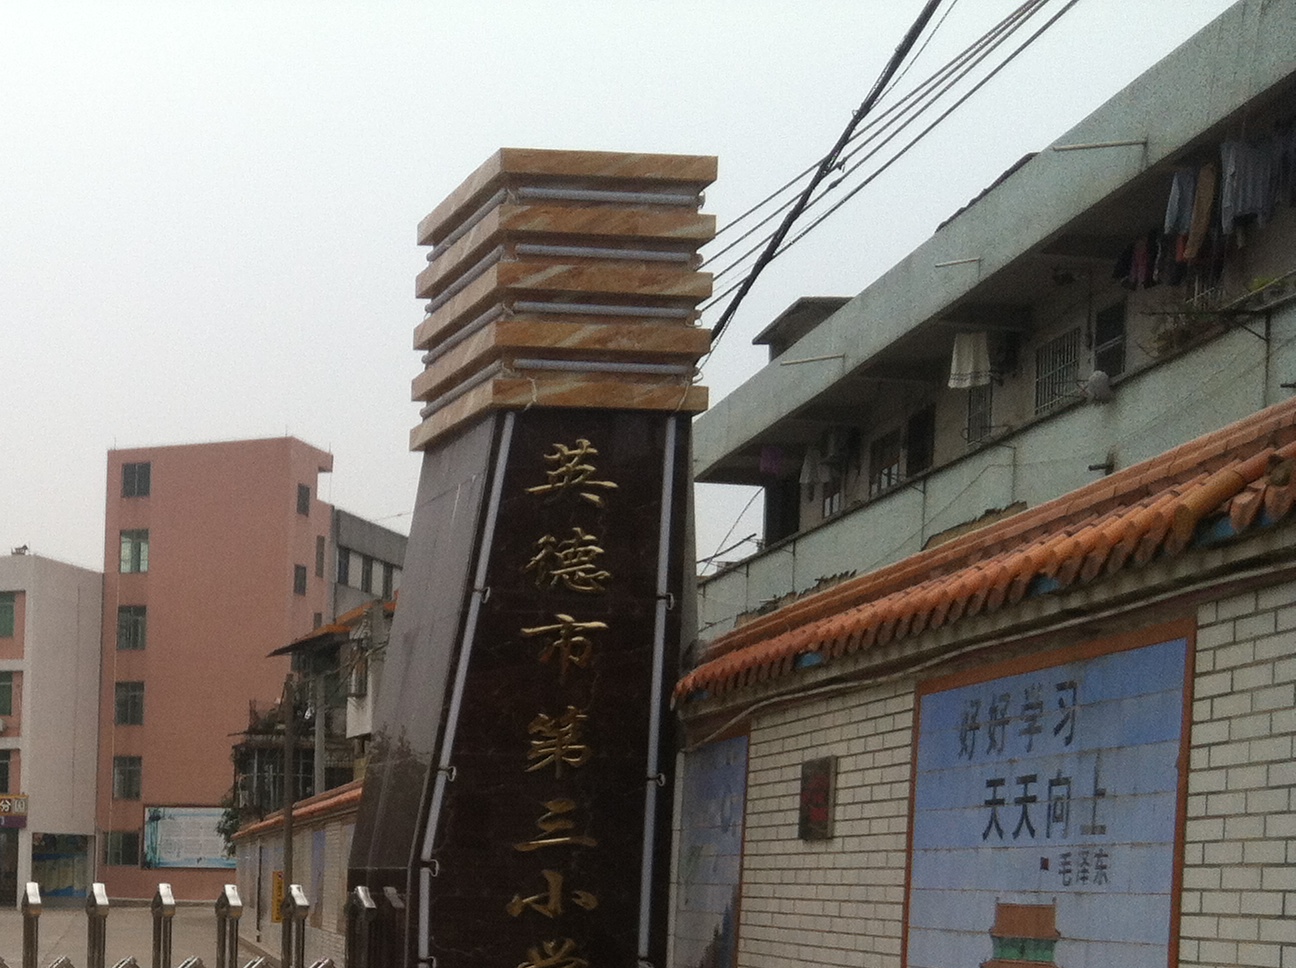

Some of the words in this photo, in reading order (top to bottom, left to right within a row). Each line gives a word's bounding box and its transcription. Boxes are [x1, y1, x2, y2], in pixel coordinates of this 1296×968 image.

[958, 680, 1078, 761] 好好学习
[982, 750, 1107, 841] 天天向上
[1058, 849, 1109, 887] 毛泽东
